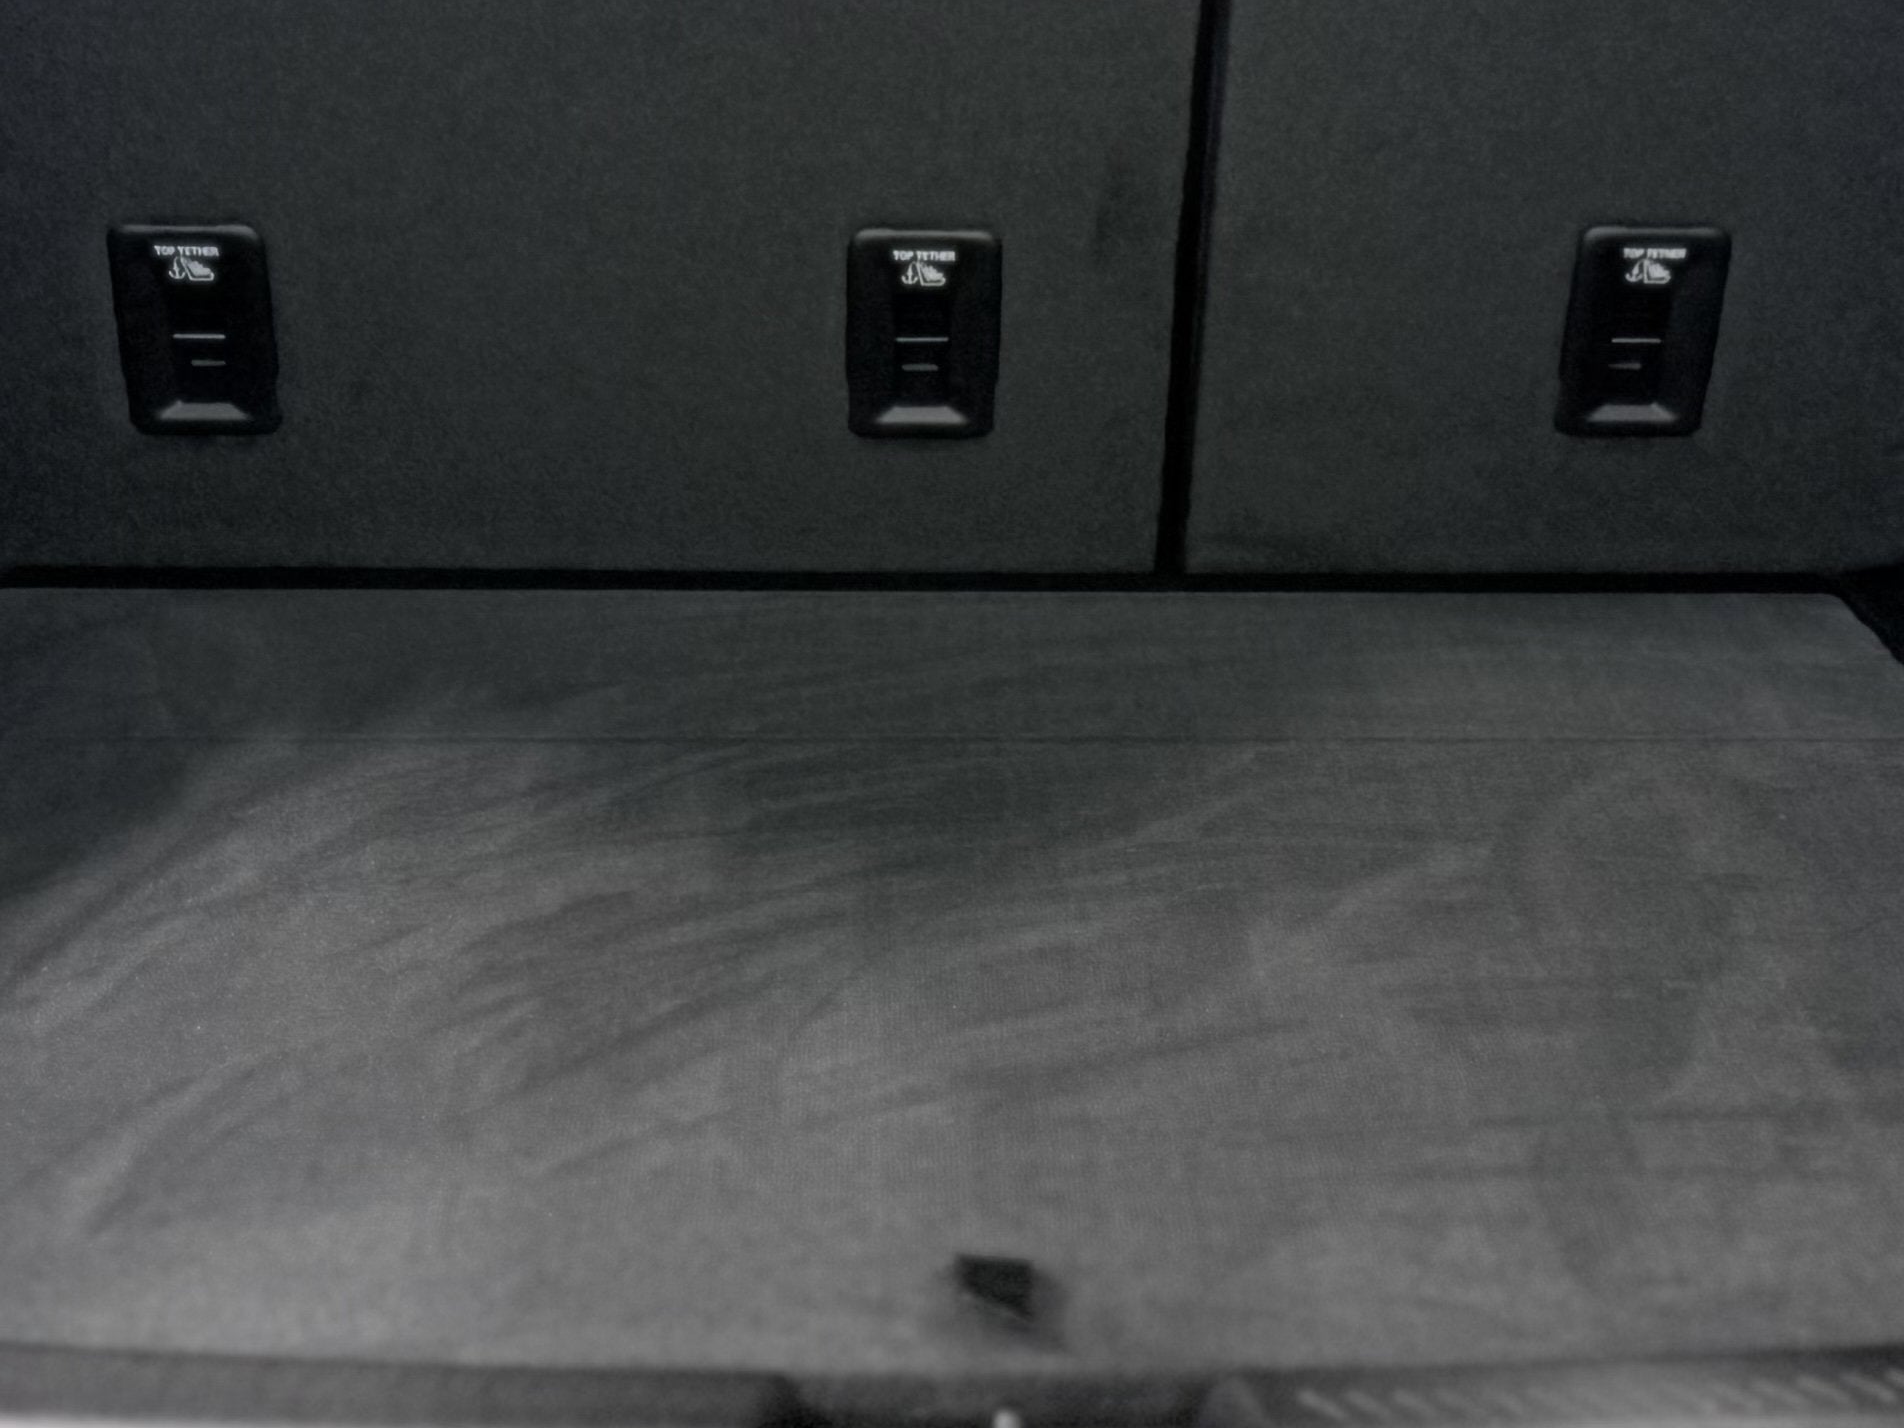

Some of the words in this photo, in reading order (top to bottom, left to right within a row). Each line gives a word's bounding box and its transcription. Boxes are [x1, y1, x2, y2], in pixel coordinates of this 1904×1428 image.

[154, 245, 175, 256] TOP
[893, 250, 914, 261] TOP
[916, 250, 956, 262] TETHER
